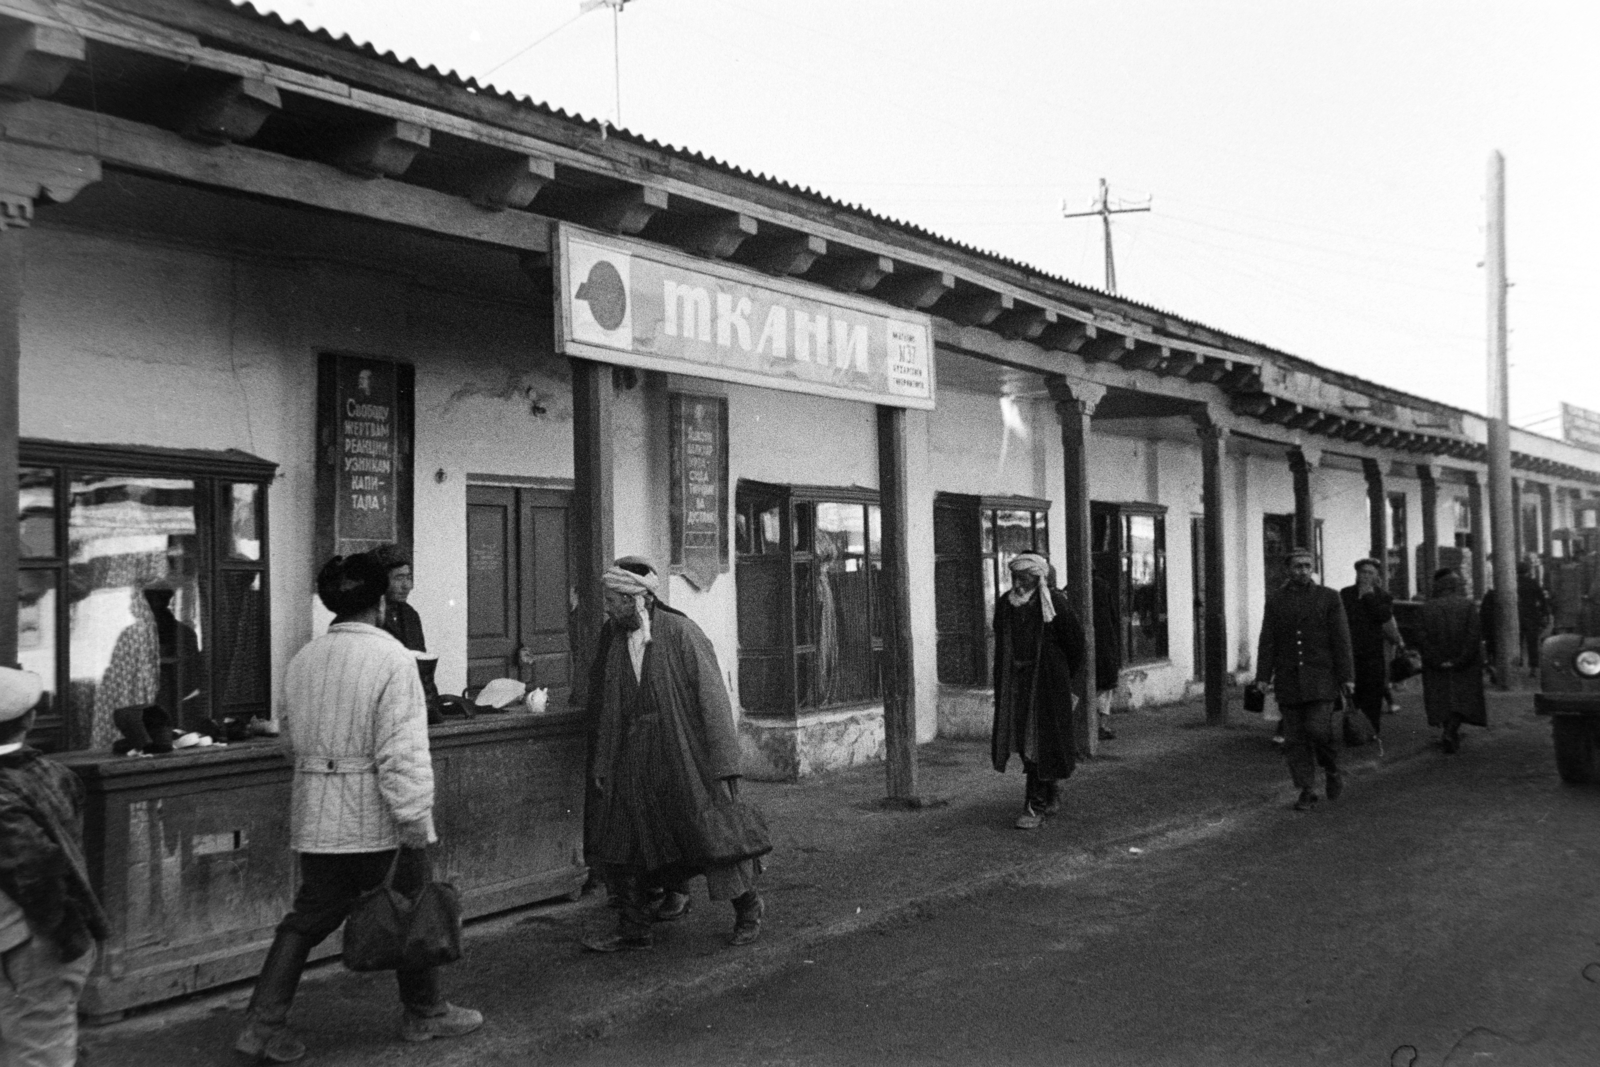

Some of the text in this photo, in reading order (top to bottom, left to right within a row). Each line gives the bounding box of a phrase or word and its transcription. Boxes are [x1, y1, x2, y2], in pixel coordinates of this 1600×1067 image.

[664, 280, 868, 374] ТКАНИ
[344, 420, 389, 437] ЖЕРТВАМ
[344, 457, 390, 473] УЗНИКАМ
[351, 475, 385, 490] КАПИ-
